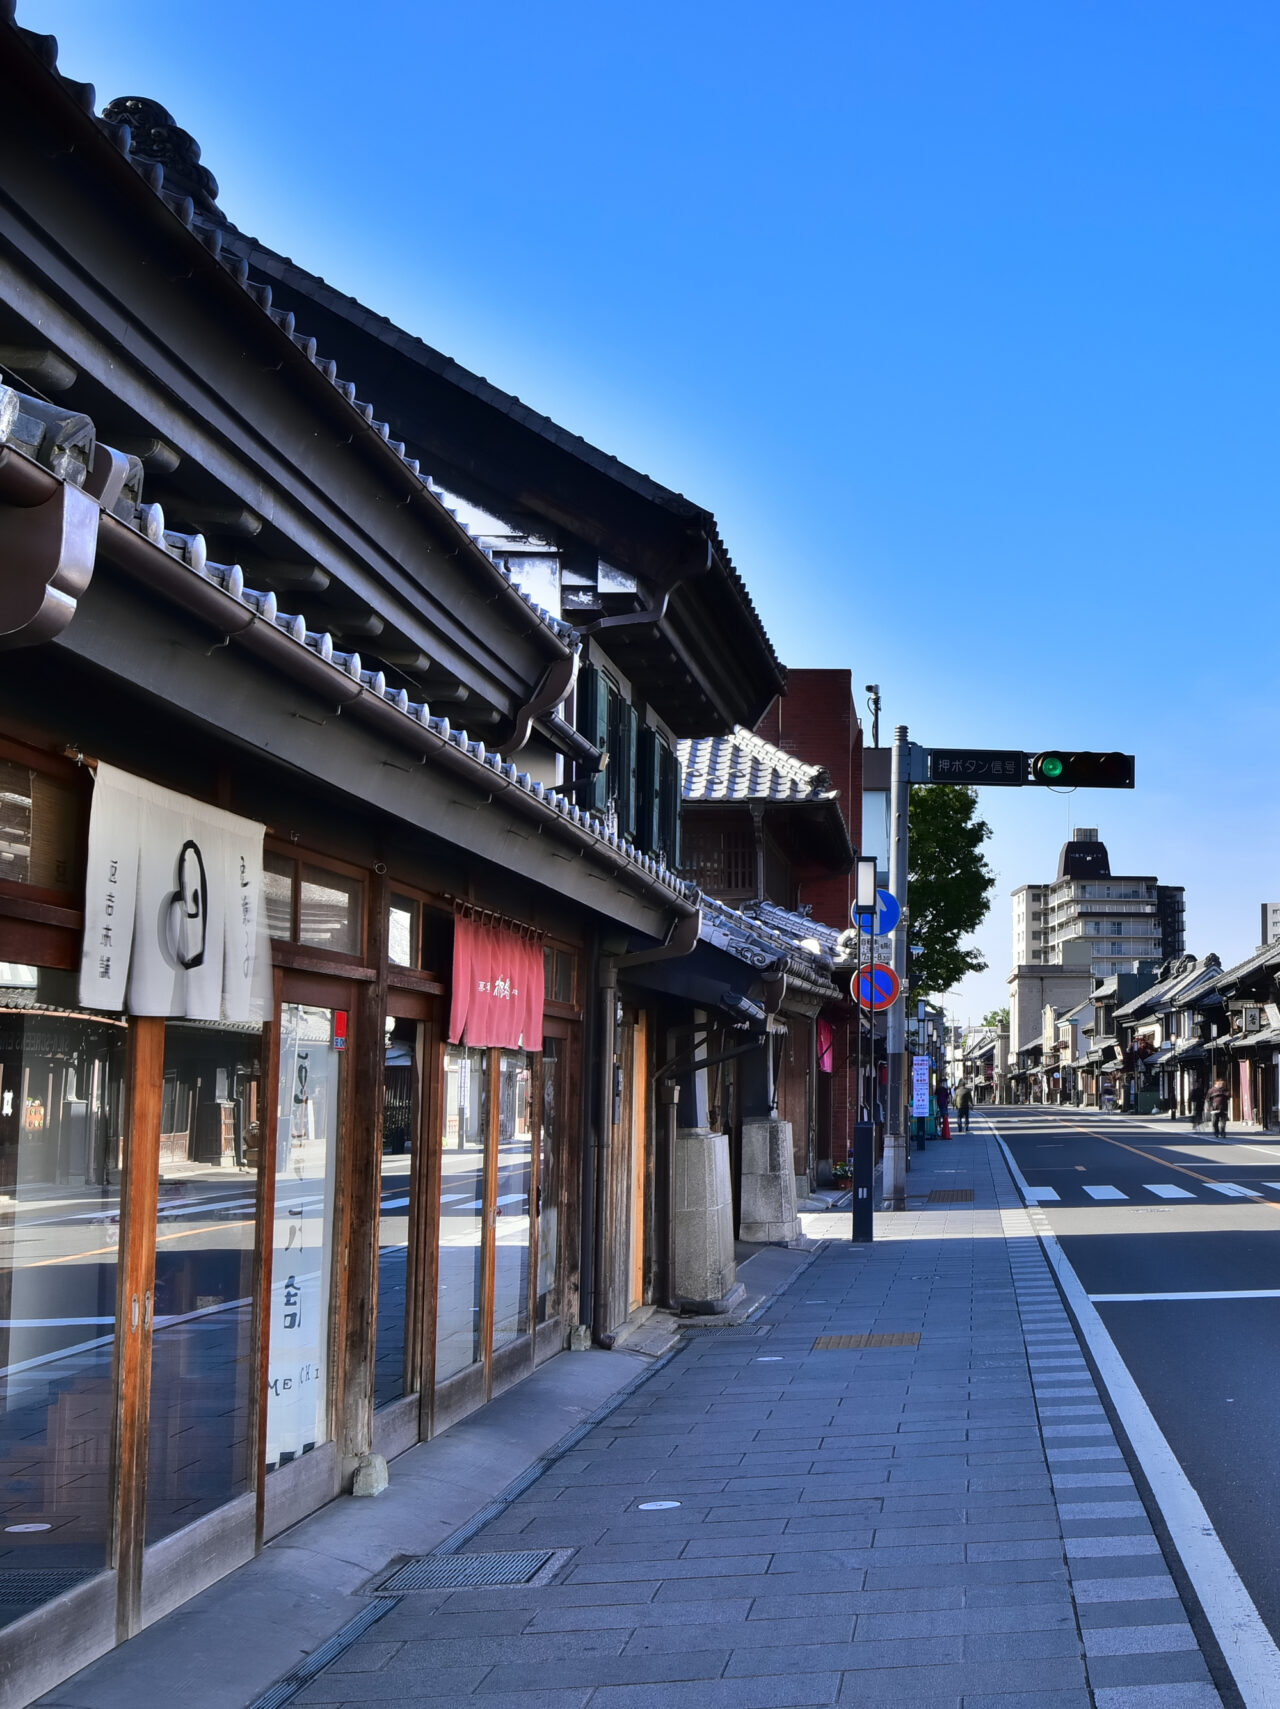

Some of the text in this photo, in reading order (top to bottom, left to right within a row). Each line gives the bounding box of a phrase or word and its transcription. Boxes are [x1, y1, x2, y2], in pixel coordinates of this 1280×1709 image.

[938, 759, 1016, 774] 押ボタン信号
